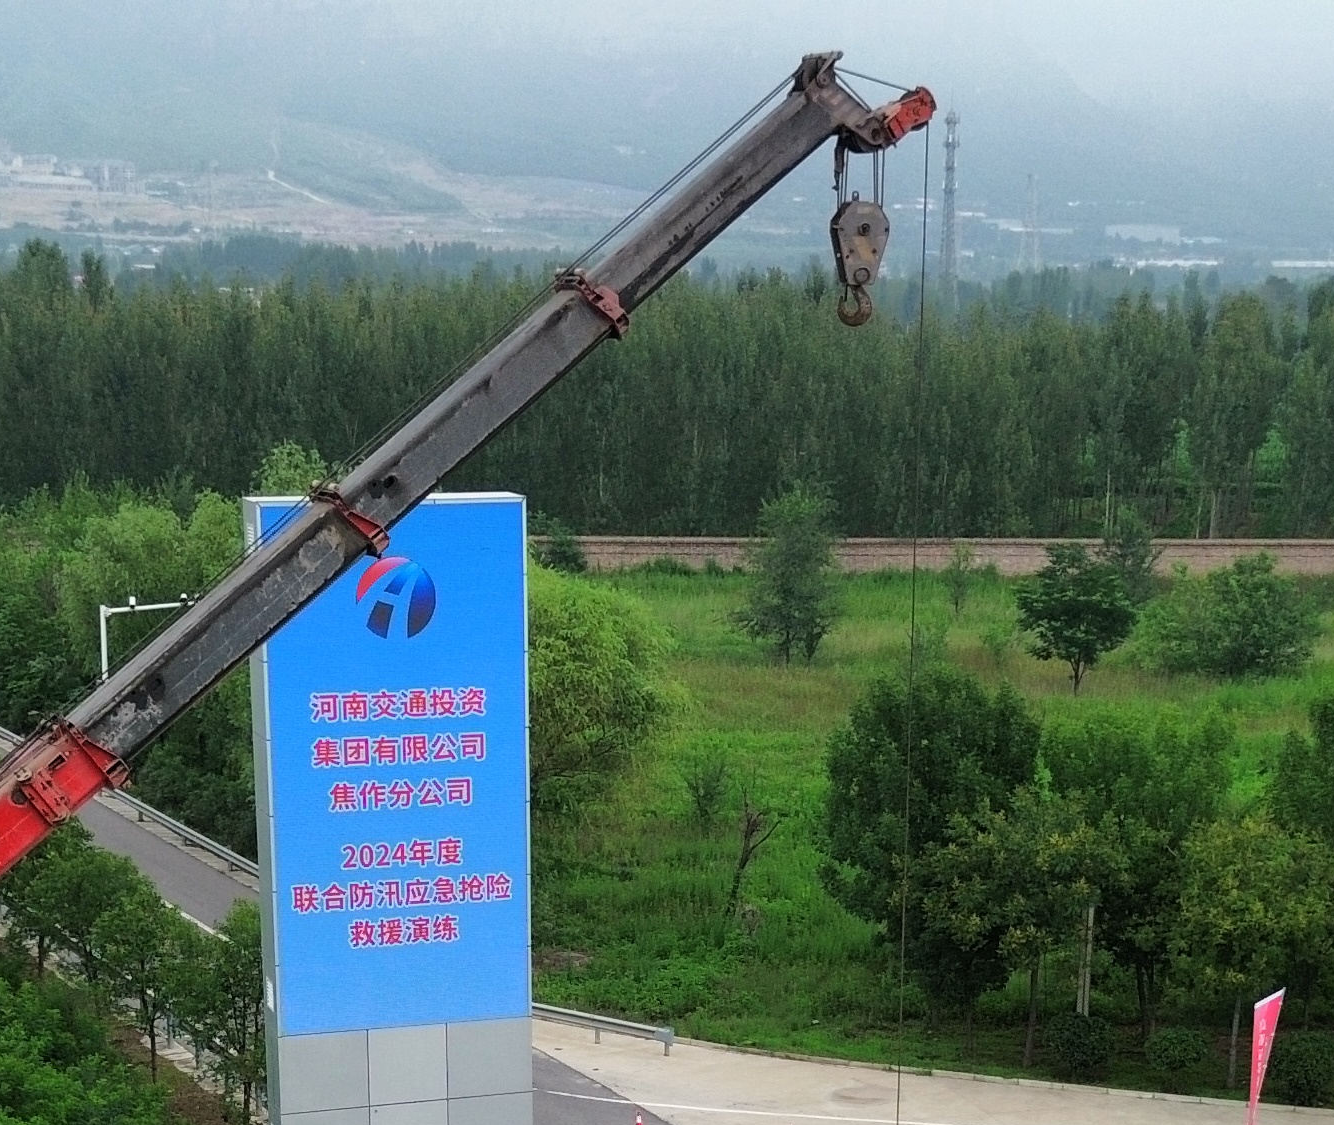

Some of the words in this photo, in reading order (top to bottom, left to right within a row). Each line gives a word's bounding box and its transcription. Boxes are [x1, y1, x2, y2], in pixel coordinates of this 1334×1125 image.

[310, 687, 487, 723] 河南交通投资
[312, 732, 487, 768] 集团有限公司
[329, 777, 473, 812] 焦作分公司
[341, 838, 463, 869] 2024年度
[292, 874, 513, 912] 联合防汛应急抢险
[349, 915, 460, 948] 救援演练
